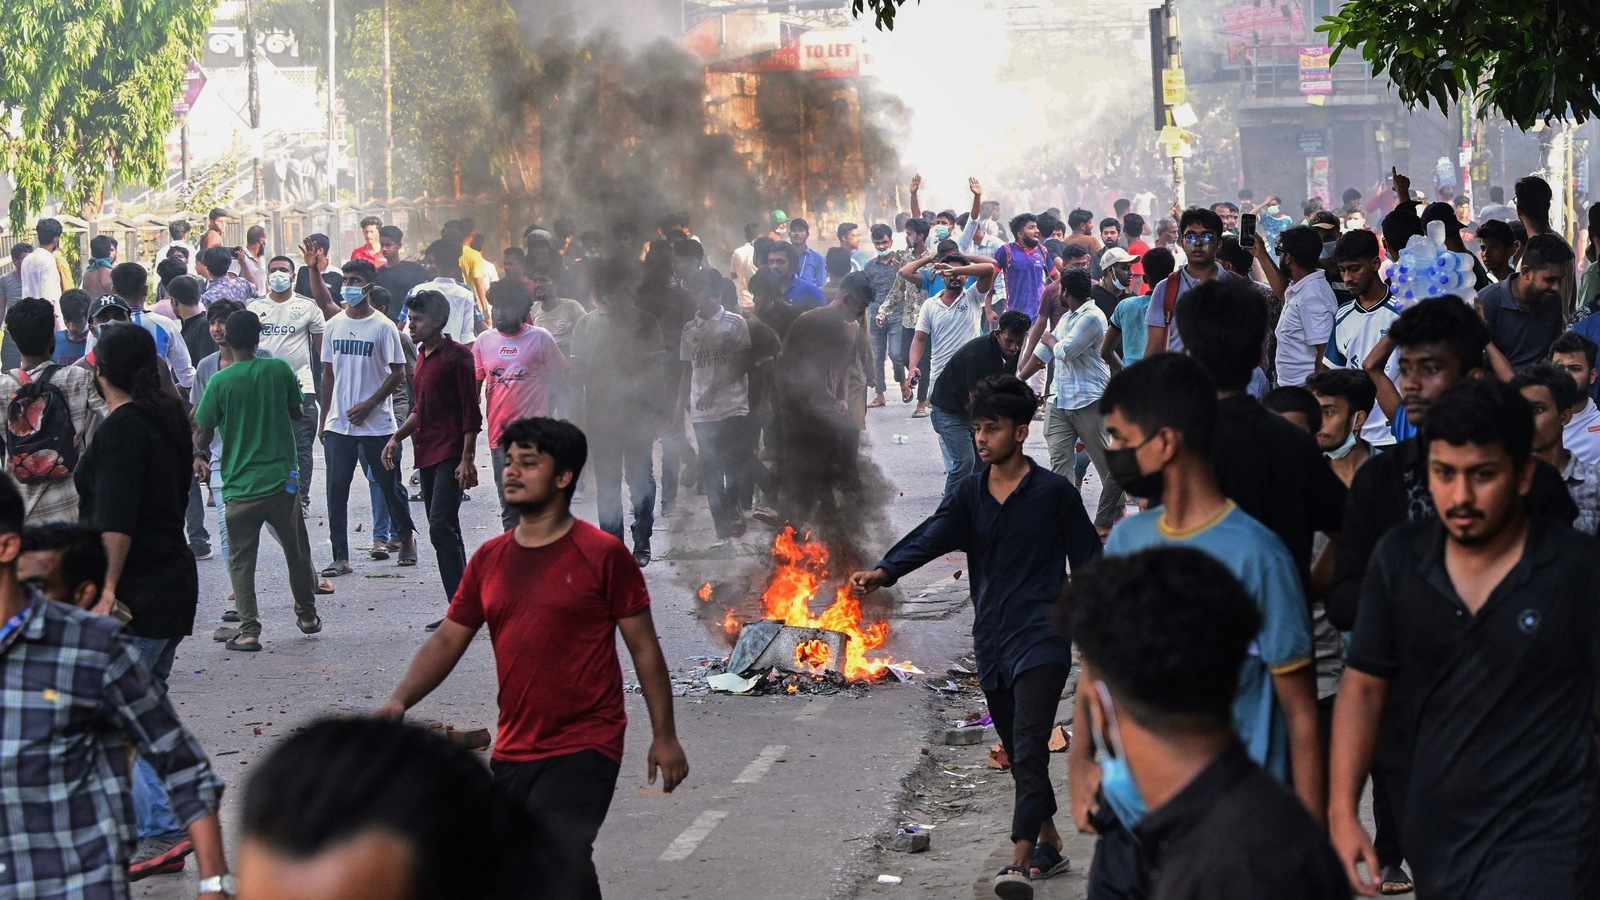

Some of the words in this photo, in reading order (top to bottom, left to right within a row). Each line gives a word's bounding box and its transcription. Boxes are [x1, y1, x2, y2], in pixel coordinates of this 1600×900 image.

[805, 45, 823, 58] TO
[828, 44, 852, 57] LET
[333, 339, 374, 357] PUMA
[500, 346, 518, 355] Fresh
